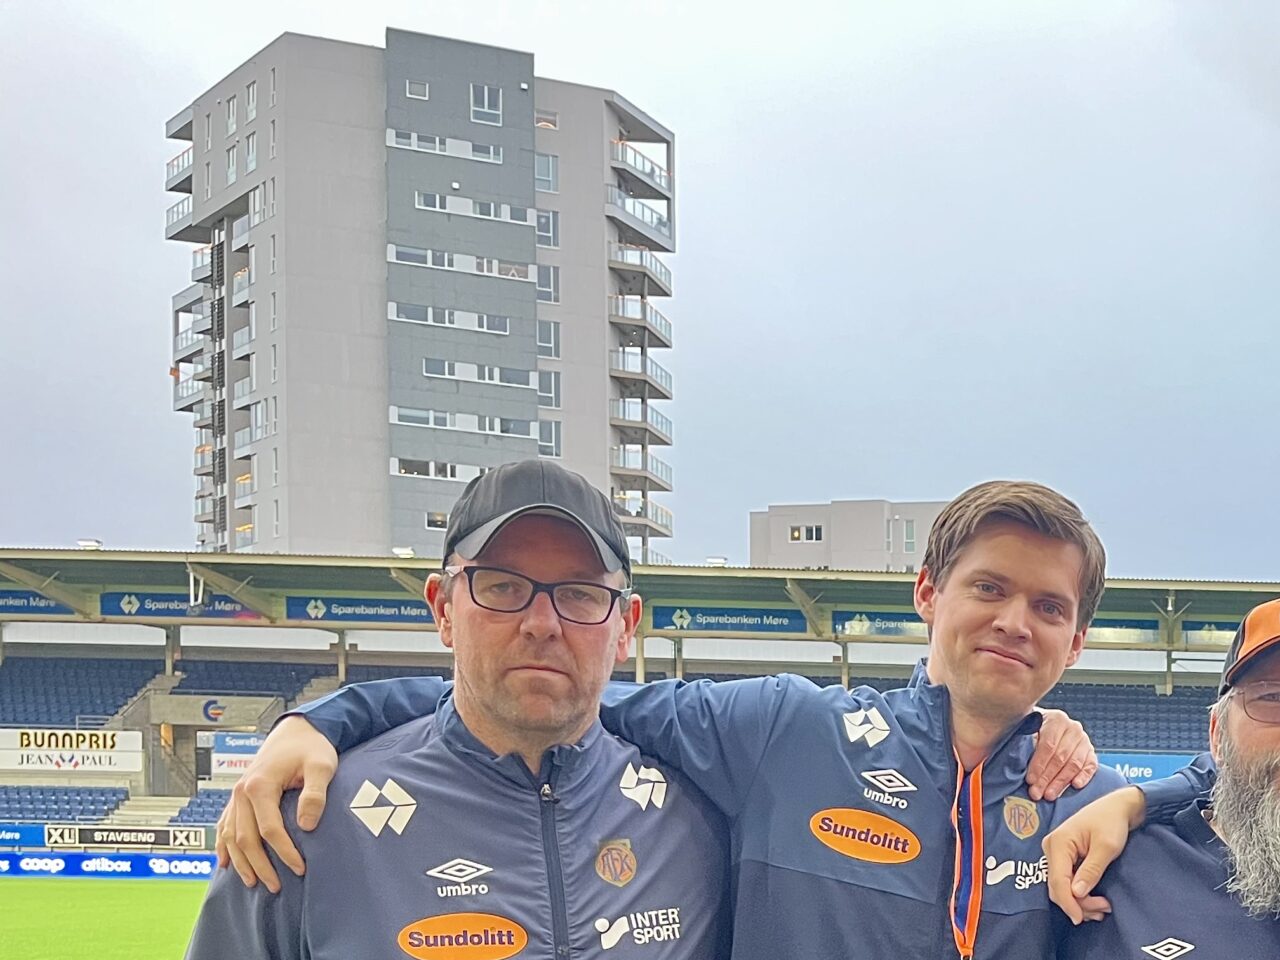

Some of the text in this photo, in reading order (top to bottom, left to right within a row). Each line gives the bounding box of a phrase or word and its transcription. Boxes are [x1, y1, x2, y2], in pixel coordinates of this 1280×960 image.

[215, 601, 241, 611] Møre
[331, 604, 427, 616] Sparebanken Møre
[696, 614, 789, 626] Sparebanken Møre
[20, 732, 116, 749] BUNNPRIS
[18, 754, 116, 767] JEAN PAUL
[863, 787, 908, 809] umbro
[94, 831, 155, 843] STAVSENG
[818, 816, 910, 854] Sundolitt
[20, 858, 65, 873] coop
[437, 882, 489, 897] umbro
[630, 909, 680, 928] INTER
[408, 930, 515, 948] Sundolitt
[633, 923, 681, 944] SPORT
